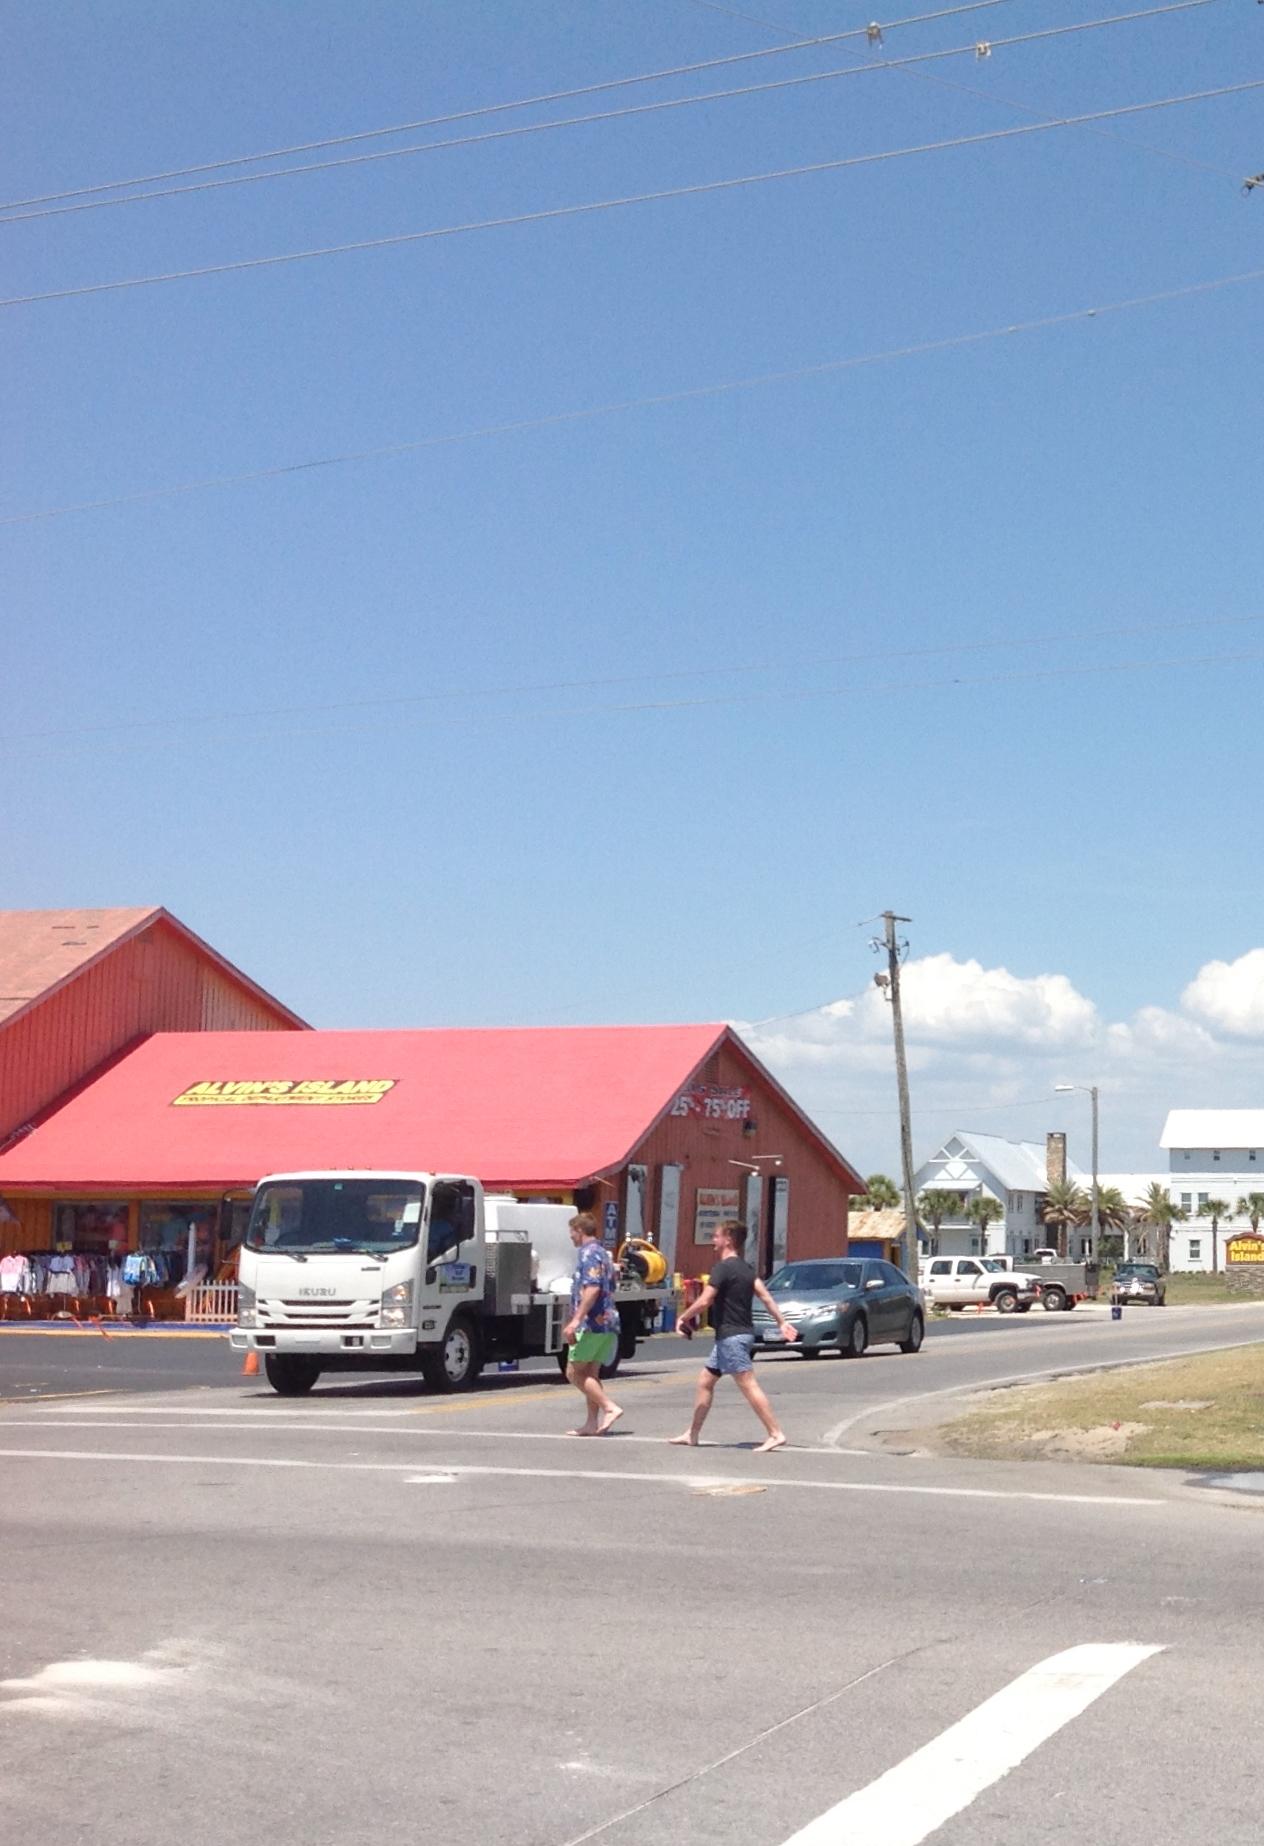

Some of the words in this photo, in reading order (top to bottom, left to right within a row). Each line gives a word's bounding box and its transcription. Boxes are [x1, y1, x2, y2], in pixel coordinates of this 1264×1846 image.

[186, 1080, 293, 1095] ALVIN'S
[294, 1079, 394, 1094] ISLAND
[727, 1099, 751, 1119] OFF
[605, 1203, 617, 1240] ATM
